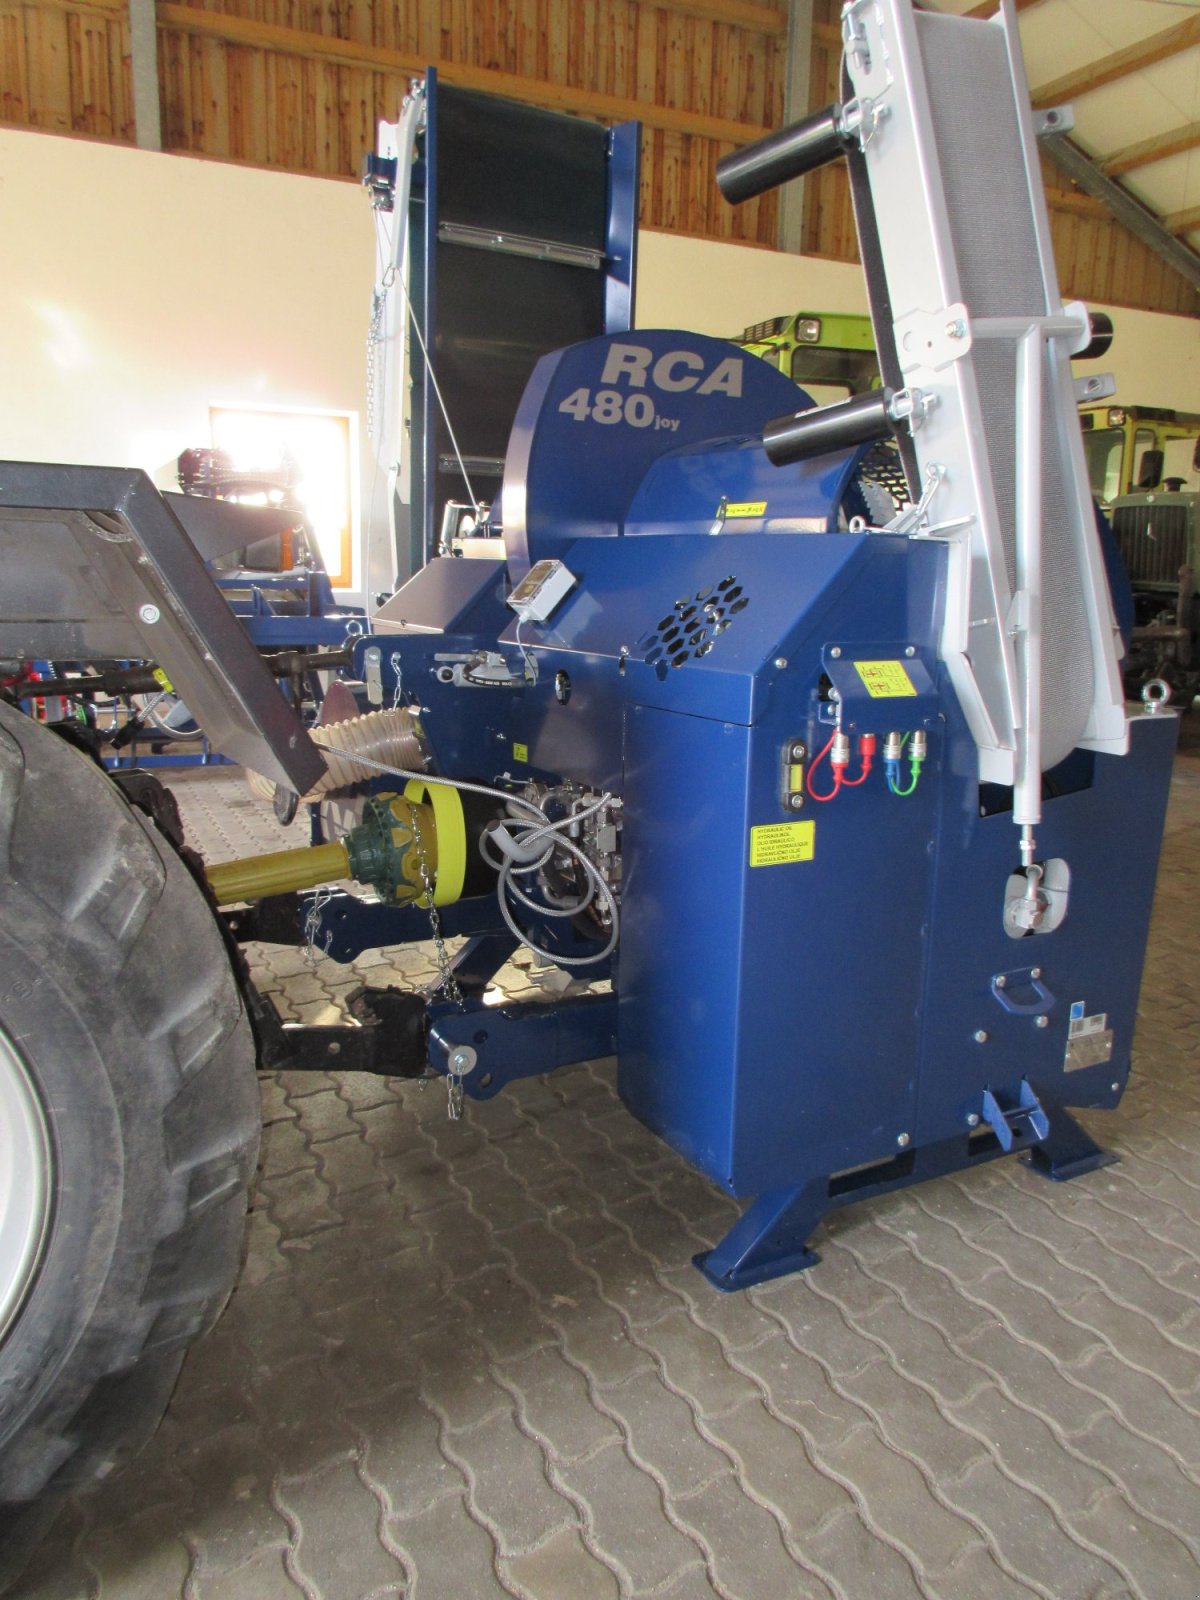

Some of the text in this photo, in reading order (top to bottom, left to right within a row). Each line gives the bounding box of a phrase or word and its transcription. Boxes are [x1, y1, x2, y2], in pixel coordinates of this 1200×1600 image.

[600, 343, 743, 397] RCA
[558, 388, 680, 431] 480 joy
